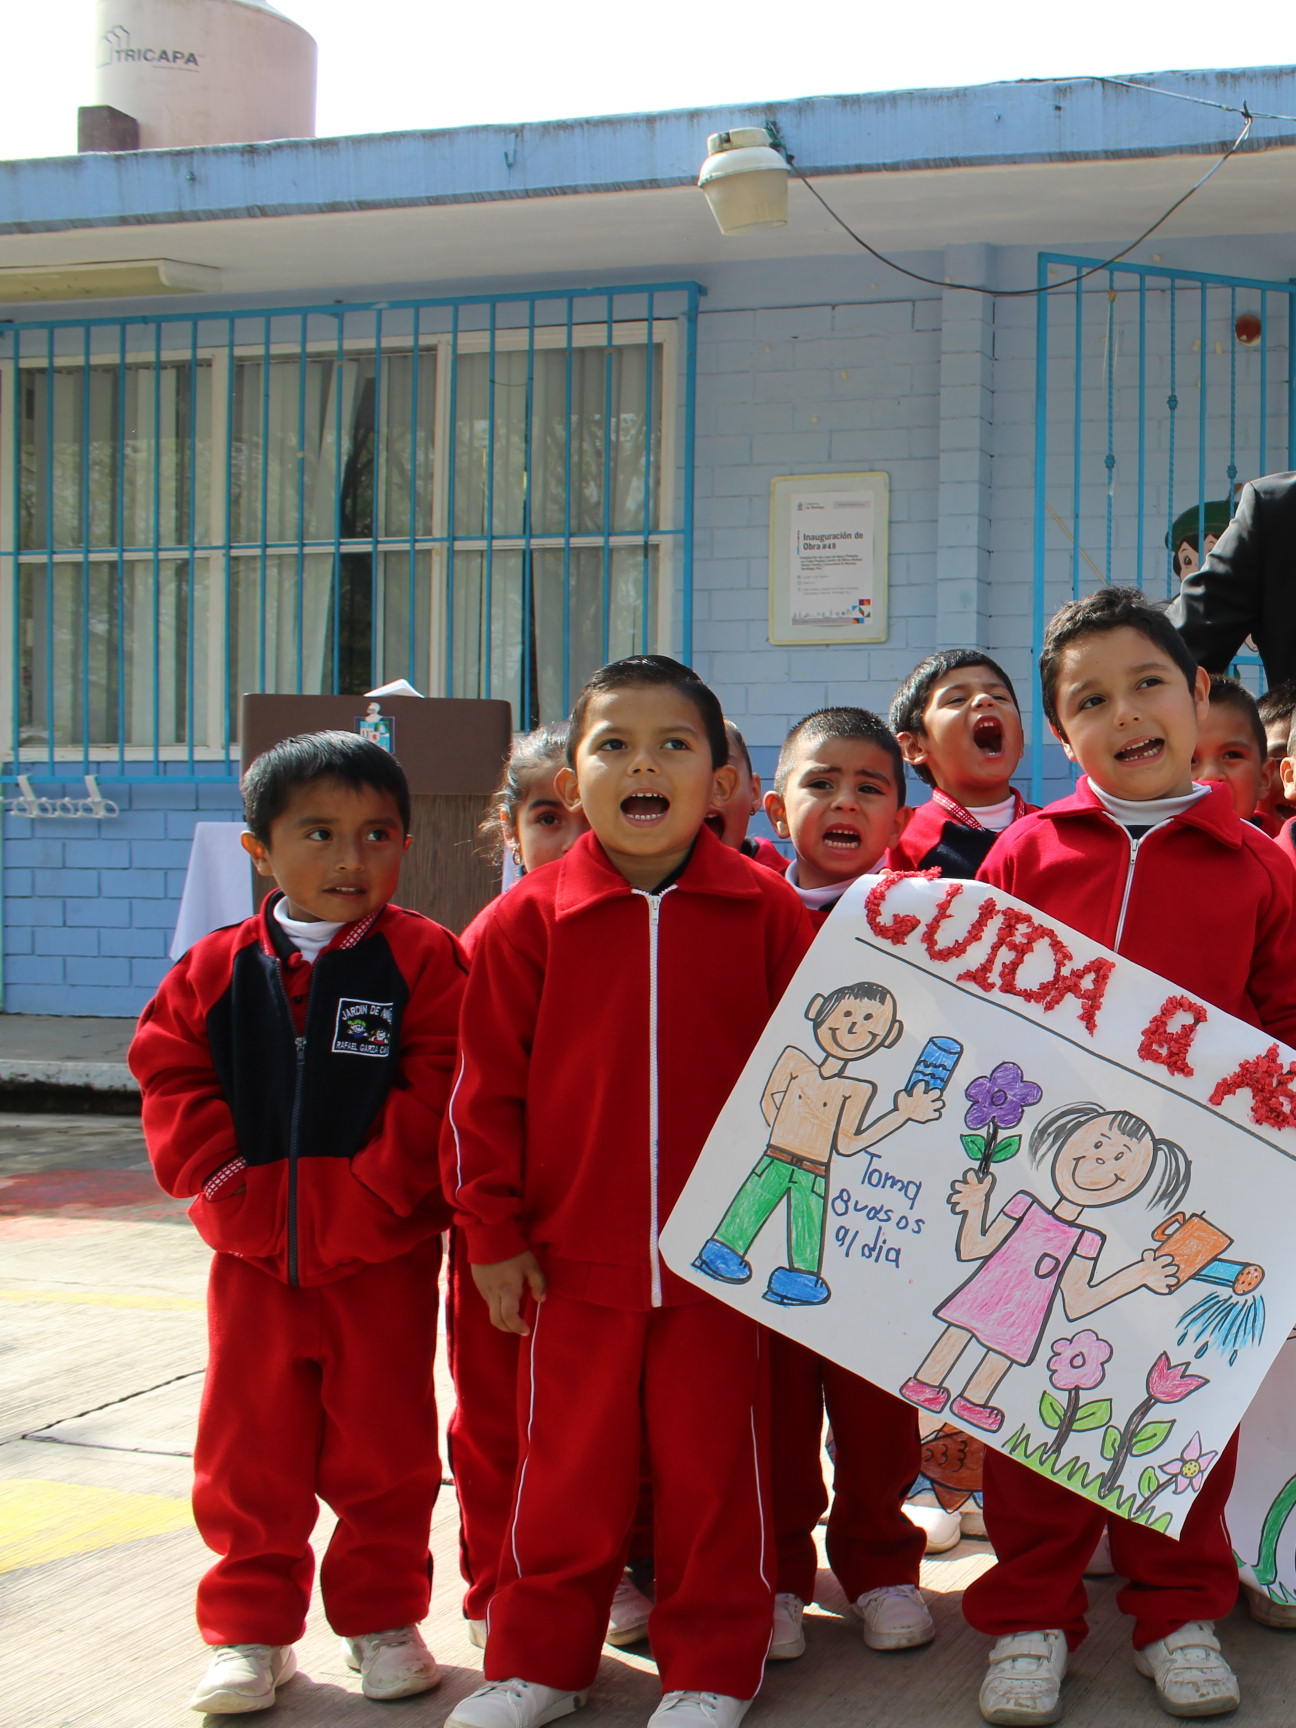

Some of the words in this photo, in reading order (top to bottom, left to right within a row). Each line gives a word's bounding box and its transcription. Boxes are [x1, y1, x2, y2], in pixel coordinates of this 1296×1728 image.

[115, 48, 199, 66] TRICAPA
[803, 530, 852, 543] Inauguración
[854, 530, 864, 540] de
[803, 542, 821, 551] Obra
[864, 866, 1116, 1037] CUIDA
[342, 1005, 368, 1020] JARDIN
[369, 1005, 381, 1015] DE
[360, 1044, 379, 1054] GARZA
[861, 1150, 922, 1210] Toma
